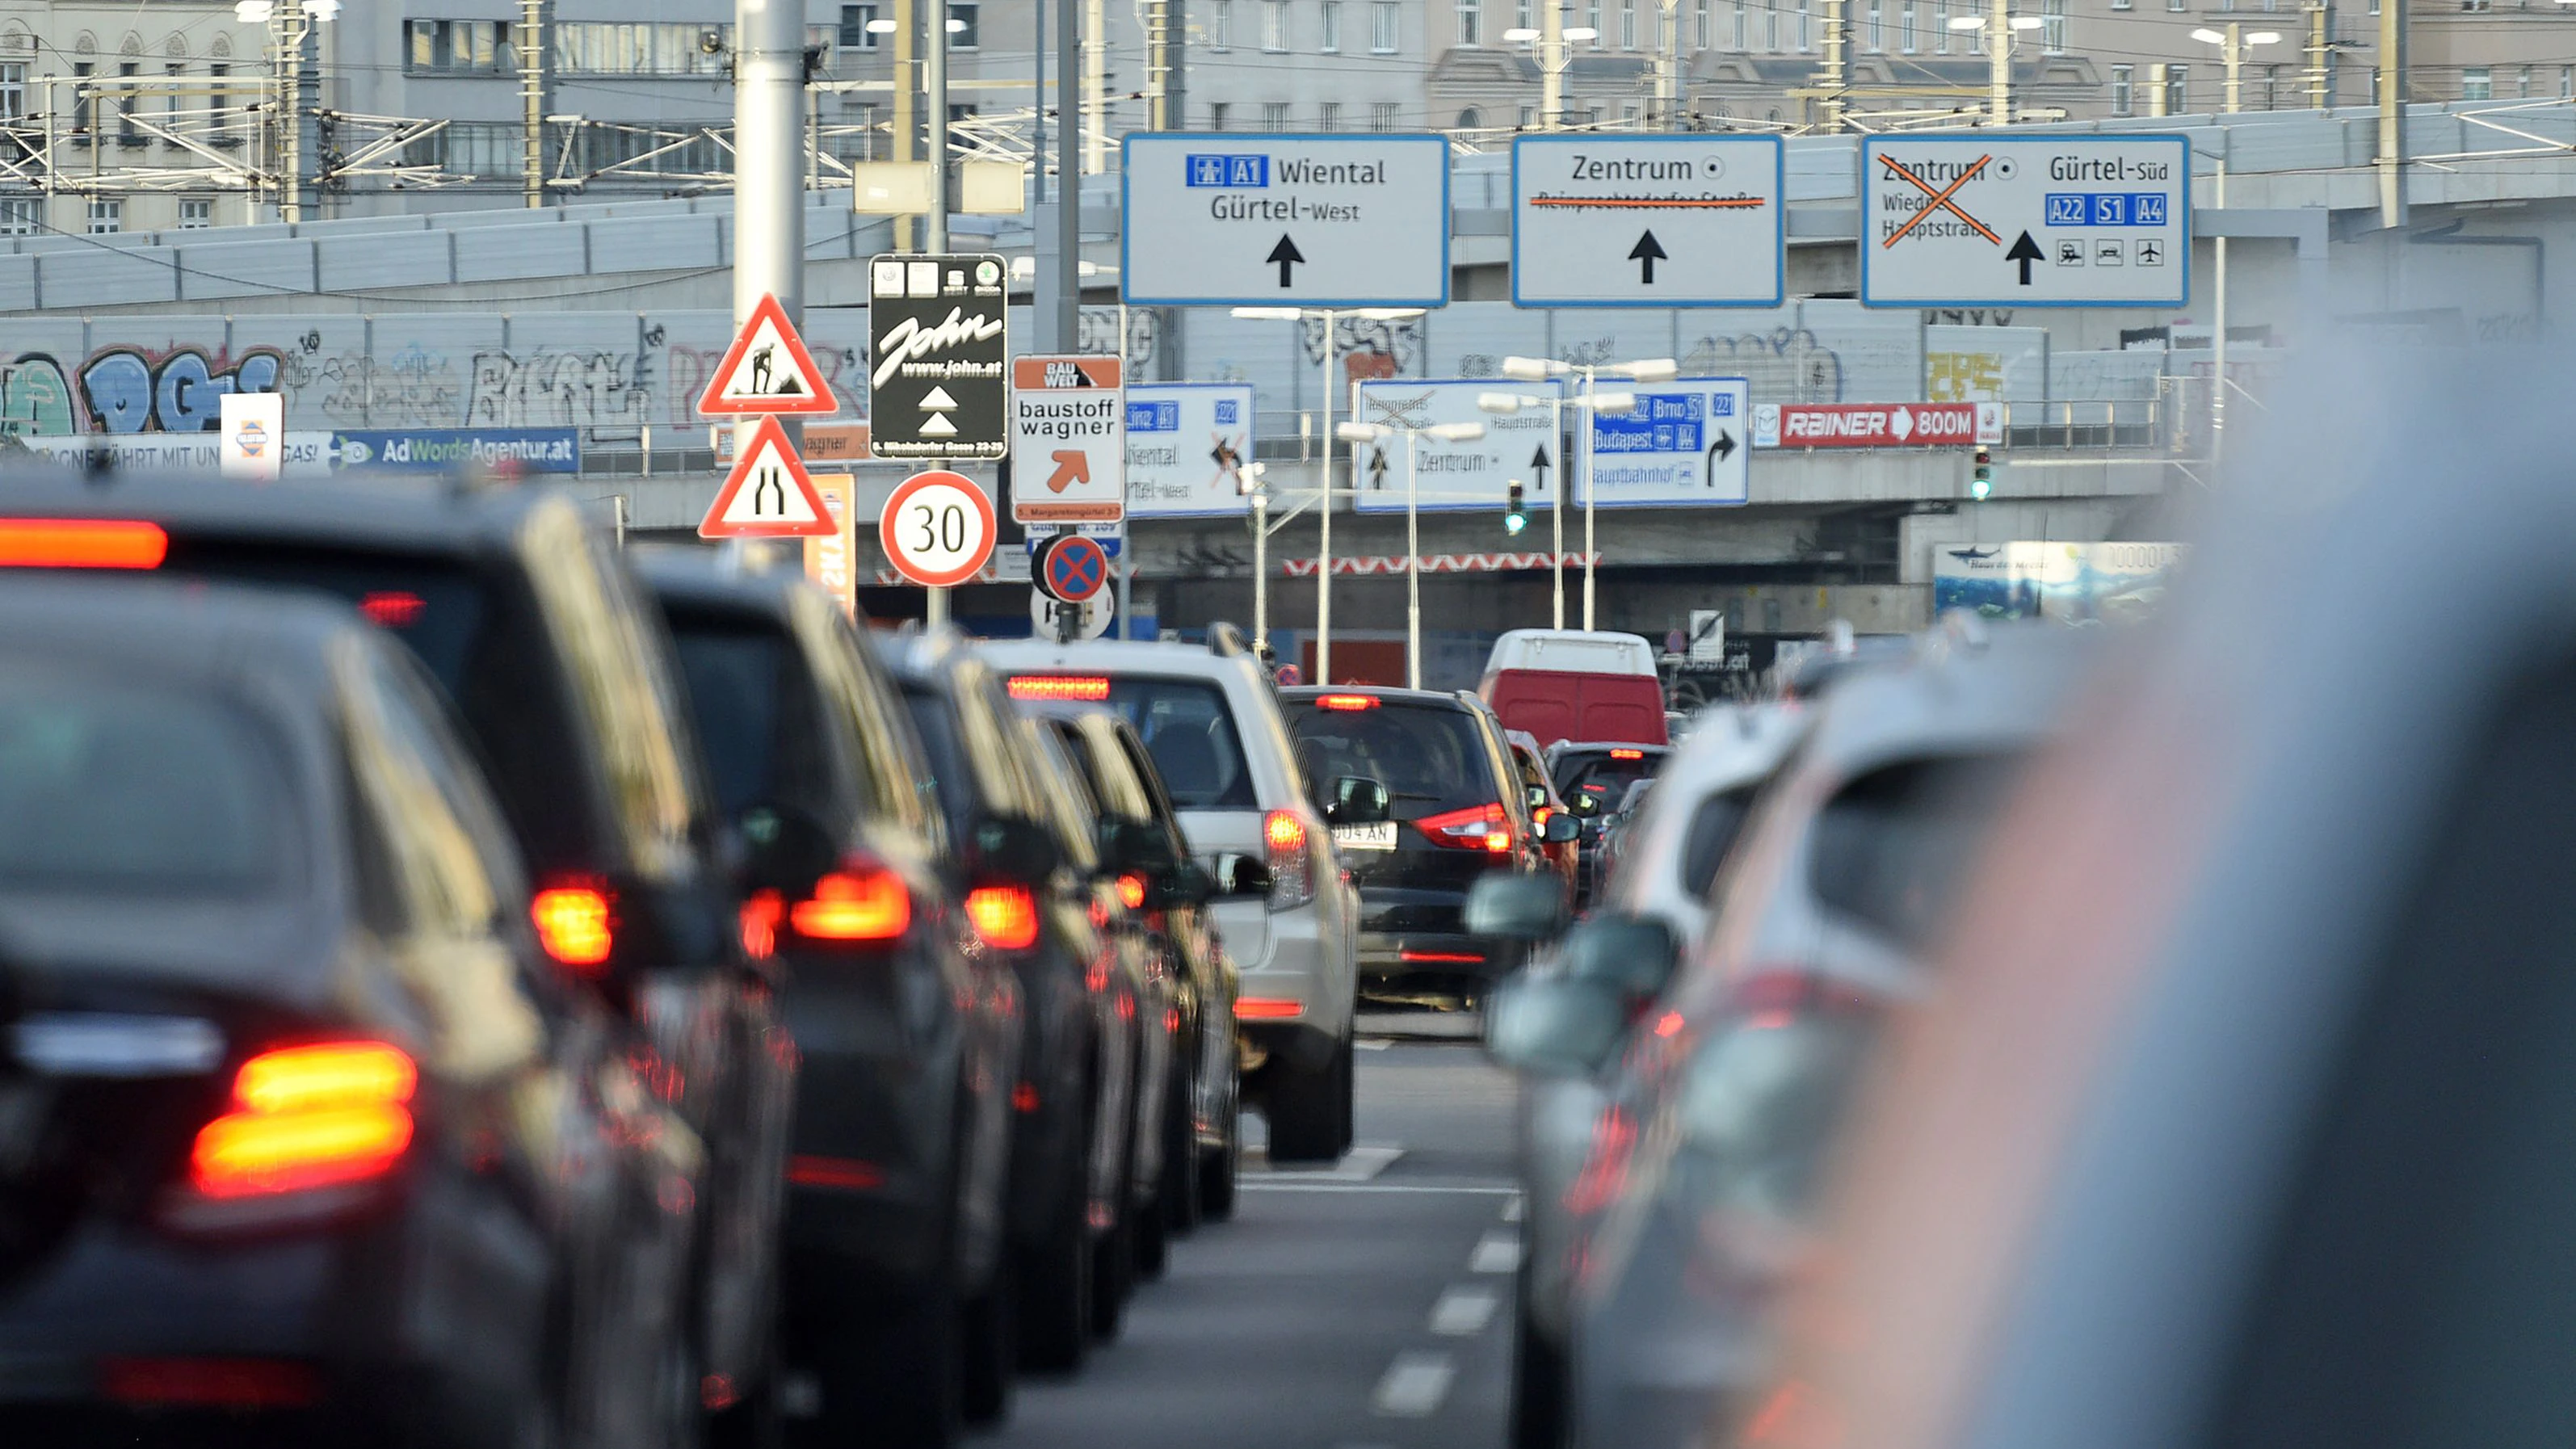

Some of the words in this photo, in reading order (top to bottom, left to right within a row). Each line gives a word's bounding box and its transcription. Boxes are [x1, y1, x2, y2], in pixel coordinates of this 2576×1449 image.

[1235, 160, 1259, 183] A1
[1279, 158, 1385, 184] Wiental
[1572, 155, 1692, 180] Zentrum
[2050, 156, 2168, 181] Gürtel-Süd
[1212, 195, 1360, 220] Gürtel-West
[2052, 199, 2083, 220] A22
[2100, 199, 2122, 220] S1
[2139, 199, 2162, 220] A4
[872, 305, 1003, 391] John
[901, 359, 1002, 380] www.john.at
[1046, 361, 1076, 375] BAU
[1044, 373, 1079, 388] WELT
[1019, 399, 1115, 418] baustoff
[1020, 421, 1115, 440] wagner
[1918, 411, 1971, 435] 800M
[162, 447, 191, 467] MIT
[382, 437, 574, 467] AdWordsAgentur.at
[1593, 465, 1677, 487] auptbahnhof
[913, 504, 964, 552] 30
